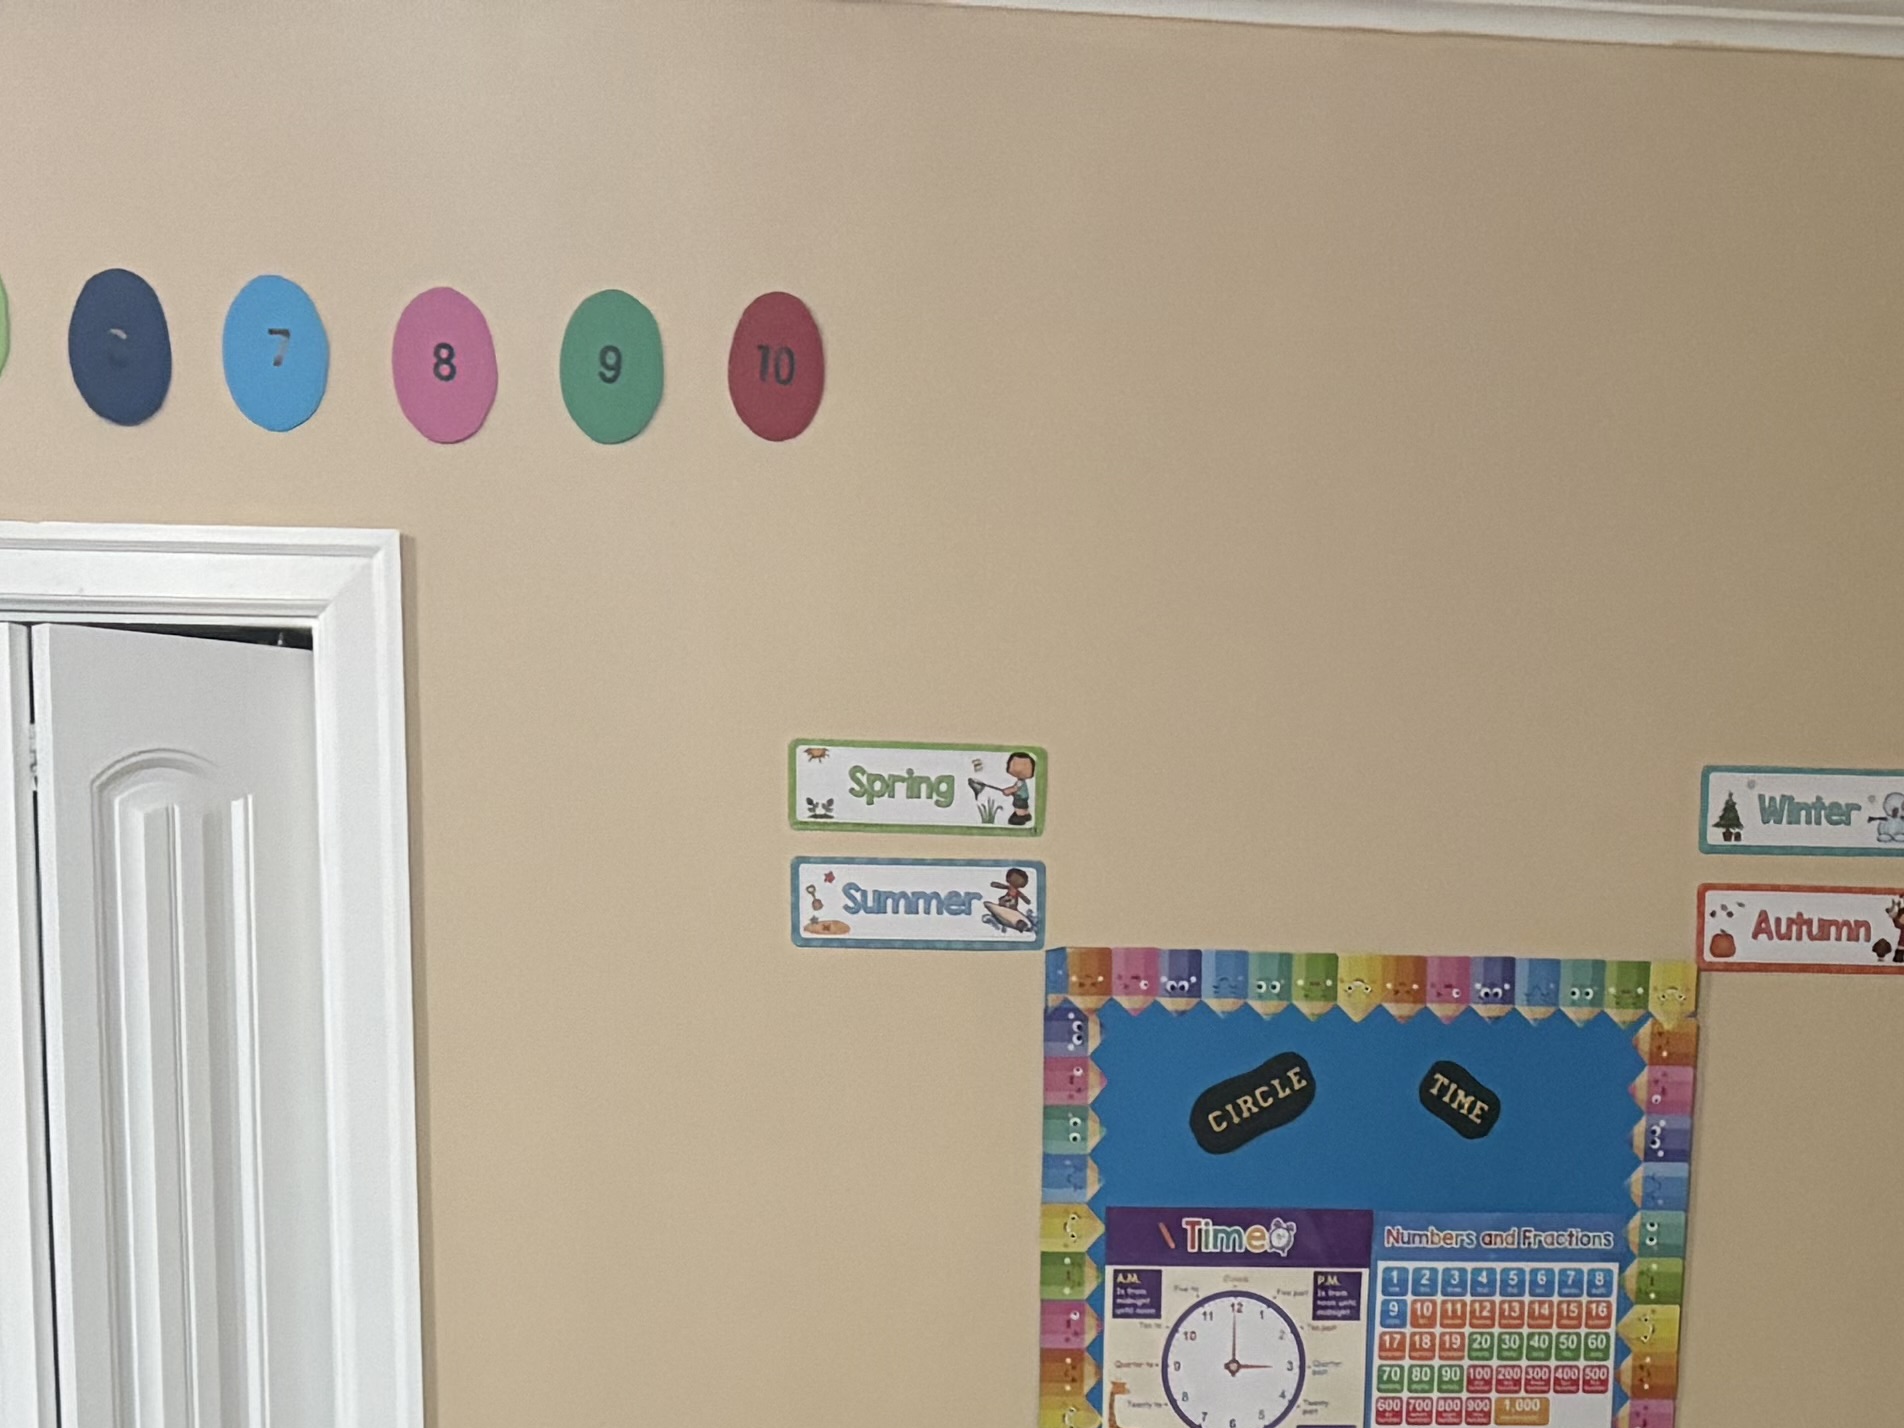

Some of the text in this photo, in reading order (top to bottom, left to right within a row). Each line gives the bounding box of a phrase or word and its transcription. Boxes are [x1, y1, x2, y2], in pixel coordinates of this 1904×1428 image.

[267, 328, 290, 366] 7
[433, 342, 457, 381] 8
[598, 345, 622, 384] 9
[756, 344, 796, 385] 10
[848, 765, 955, 808] Spring
[1758, 794, 1862, 826] Winter
[842, 882, 983, 916] Summer
[1751, 910, 1871, 942] Autumn
[1207, 1066, 1489, 1133] CIRCLE TIME
[1183, 1218, 1267, 1252] Time
[1385, 1226, 1614, 1249] Numbers and Fractions
[1391, 1271, 1604, 1285] 1 2 3 4 5 6 7 8
[1389, 1303, 1607, 1317] 9 10 11 12 13 14 15 16
[1383, 1335, 1606, 1349] 17 18 19 20 30 40 50 60
[1382, 1367, 1607, 1381] 70 80 90 100 200 300 400 500
[1376, 1398, 1541, 1412] 600 700 800 900 1,000
